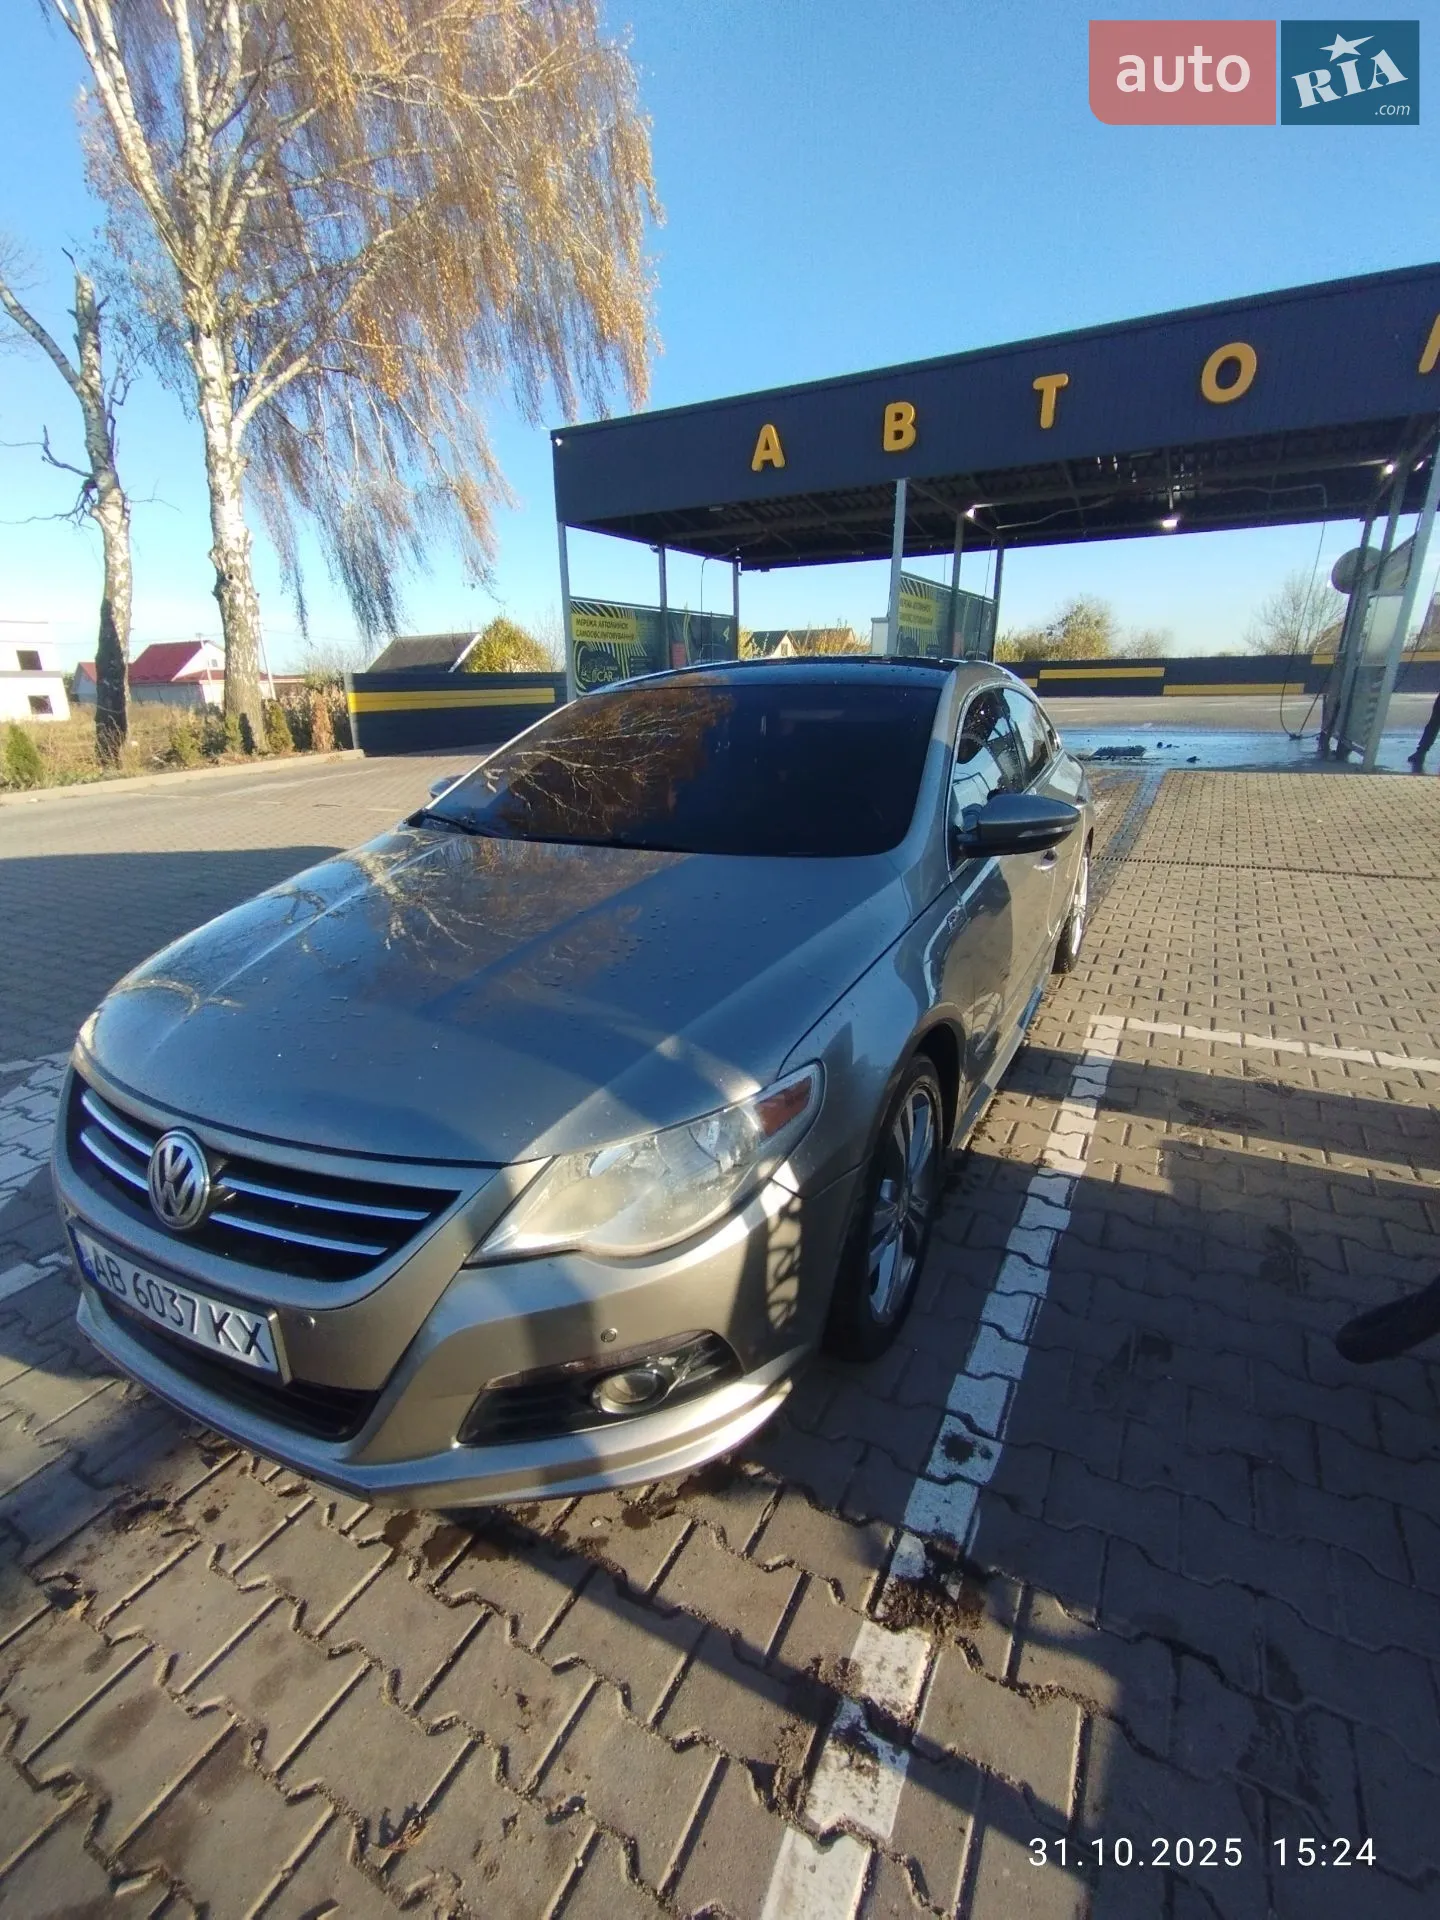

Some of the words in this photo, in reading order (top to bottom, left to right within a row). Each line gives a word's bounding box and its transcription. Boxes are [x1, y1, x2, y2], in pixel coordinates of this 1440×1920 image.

[92, 1246, 127, 1296] AB
[132, 1272, 199, 1335] 6037
[208, 1303, 270, 1363] KX
